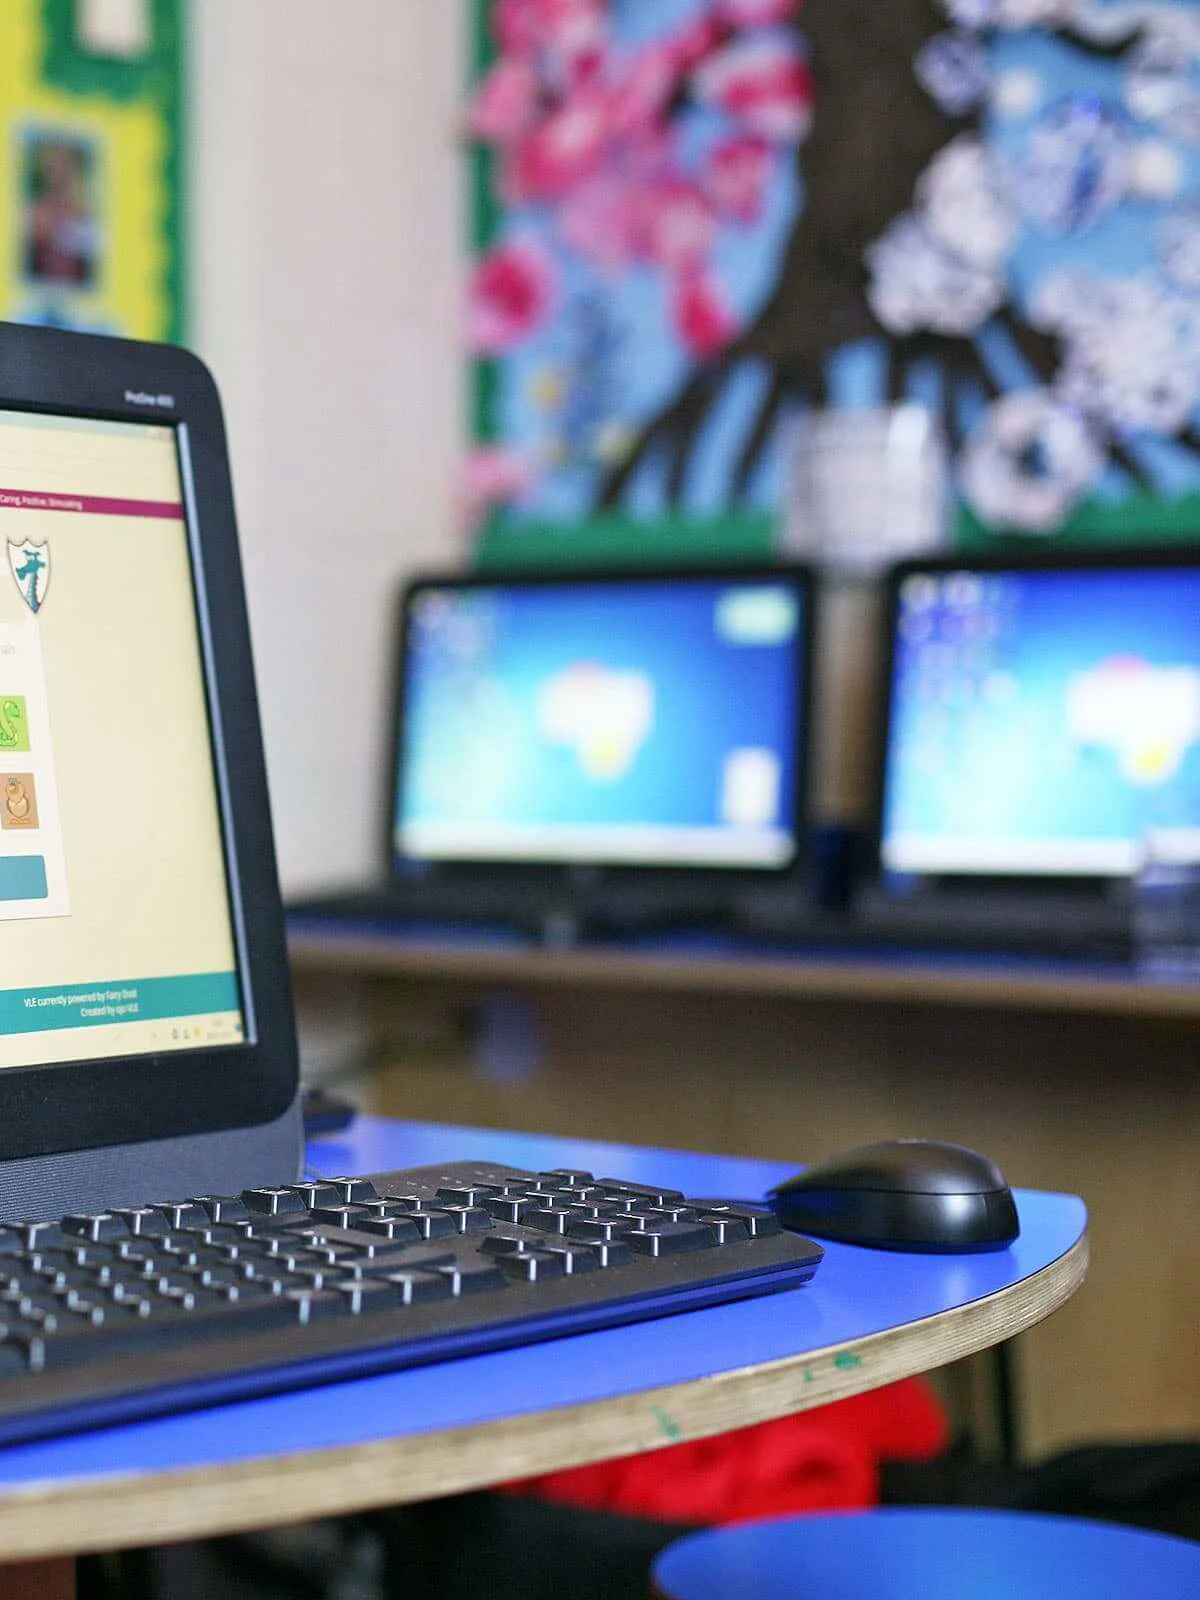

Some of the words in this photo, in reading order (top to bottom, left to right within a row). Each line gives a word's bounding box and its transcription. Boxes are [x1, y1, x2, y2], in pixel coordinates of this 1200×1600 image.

[23, 997, 38, 1008] VLE
[38, 995, 67, 1007] currently
[67, 992, 97, 1005] powered
[80, 1005, 105, 1017] Created
